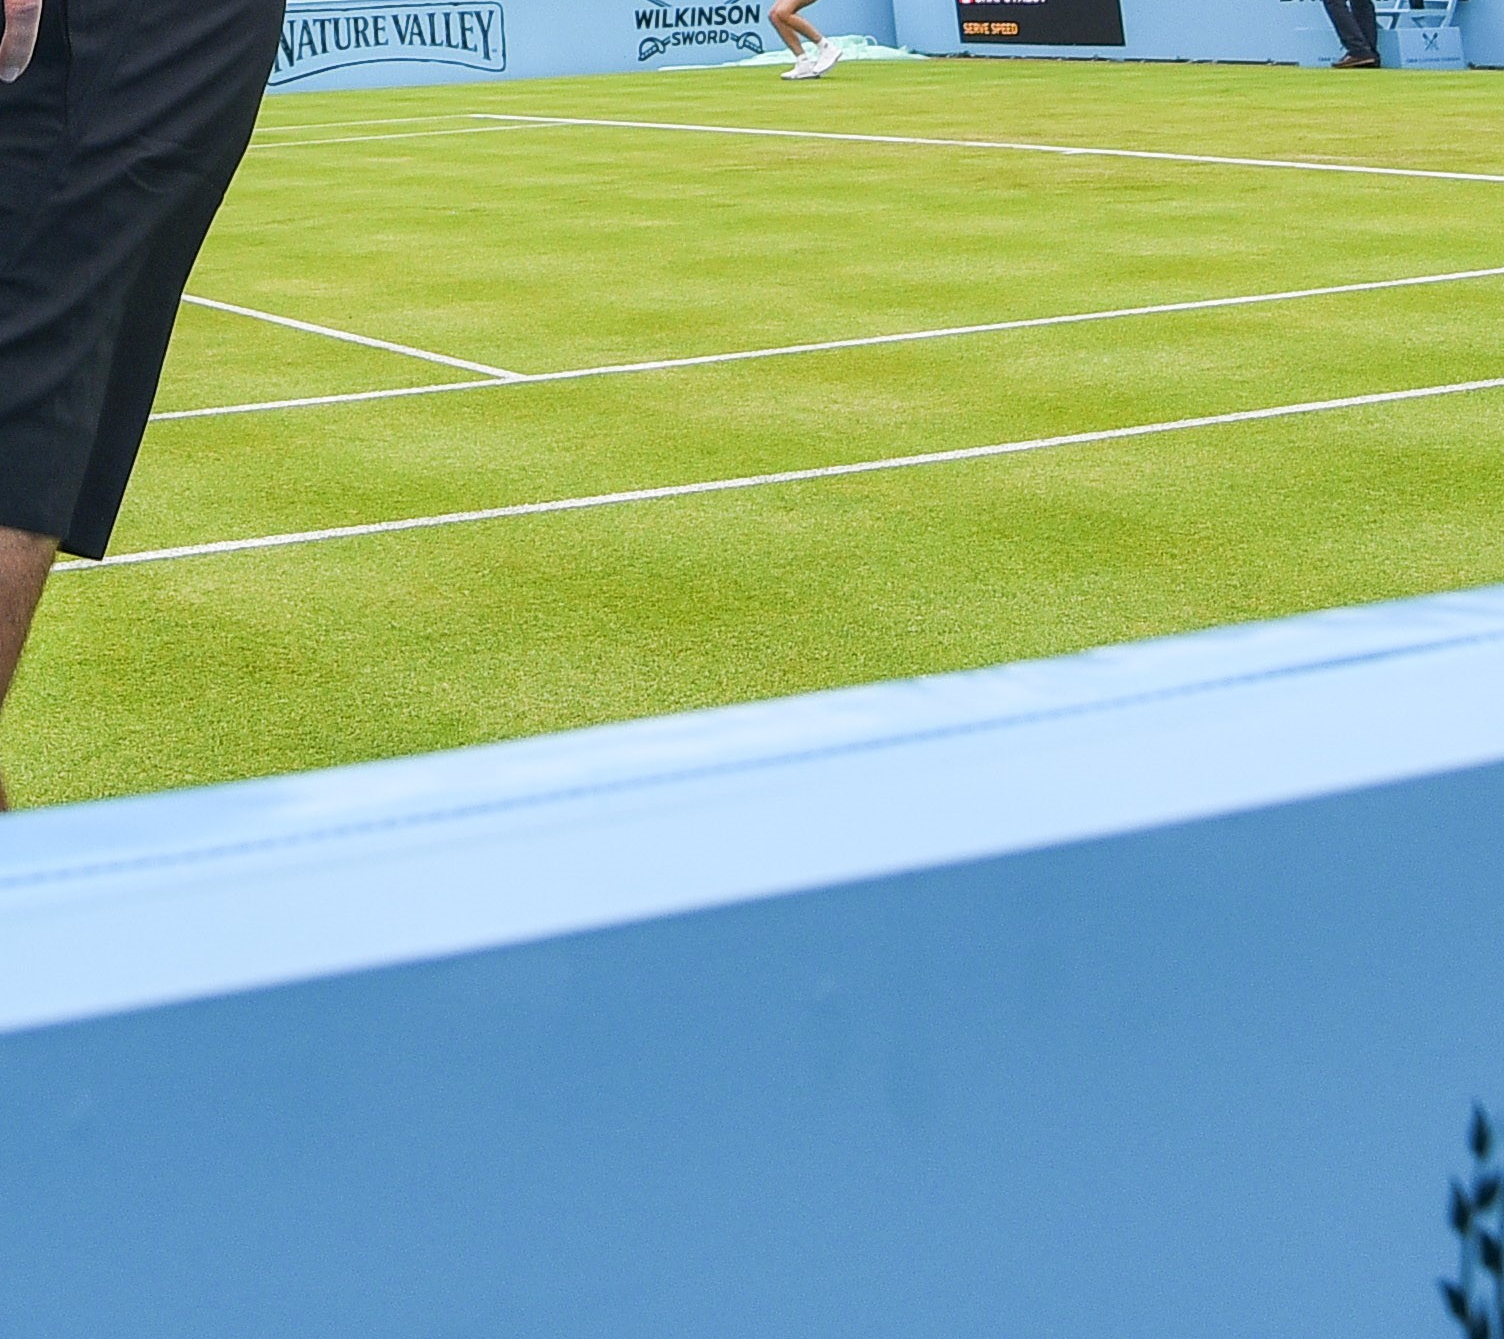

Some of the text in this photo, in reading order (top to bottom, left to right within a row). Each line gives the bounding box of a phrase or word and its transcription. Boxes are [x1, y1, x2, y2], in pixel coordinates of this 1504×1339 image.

[634, 4, 761, 30] WILKINSON
[672, 30, 730, 46] SWORD
[963, 23, 1018, 35] SERVE SPEED
[274, 9, 495, 73] NATURE VALLEY
